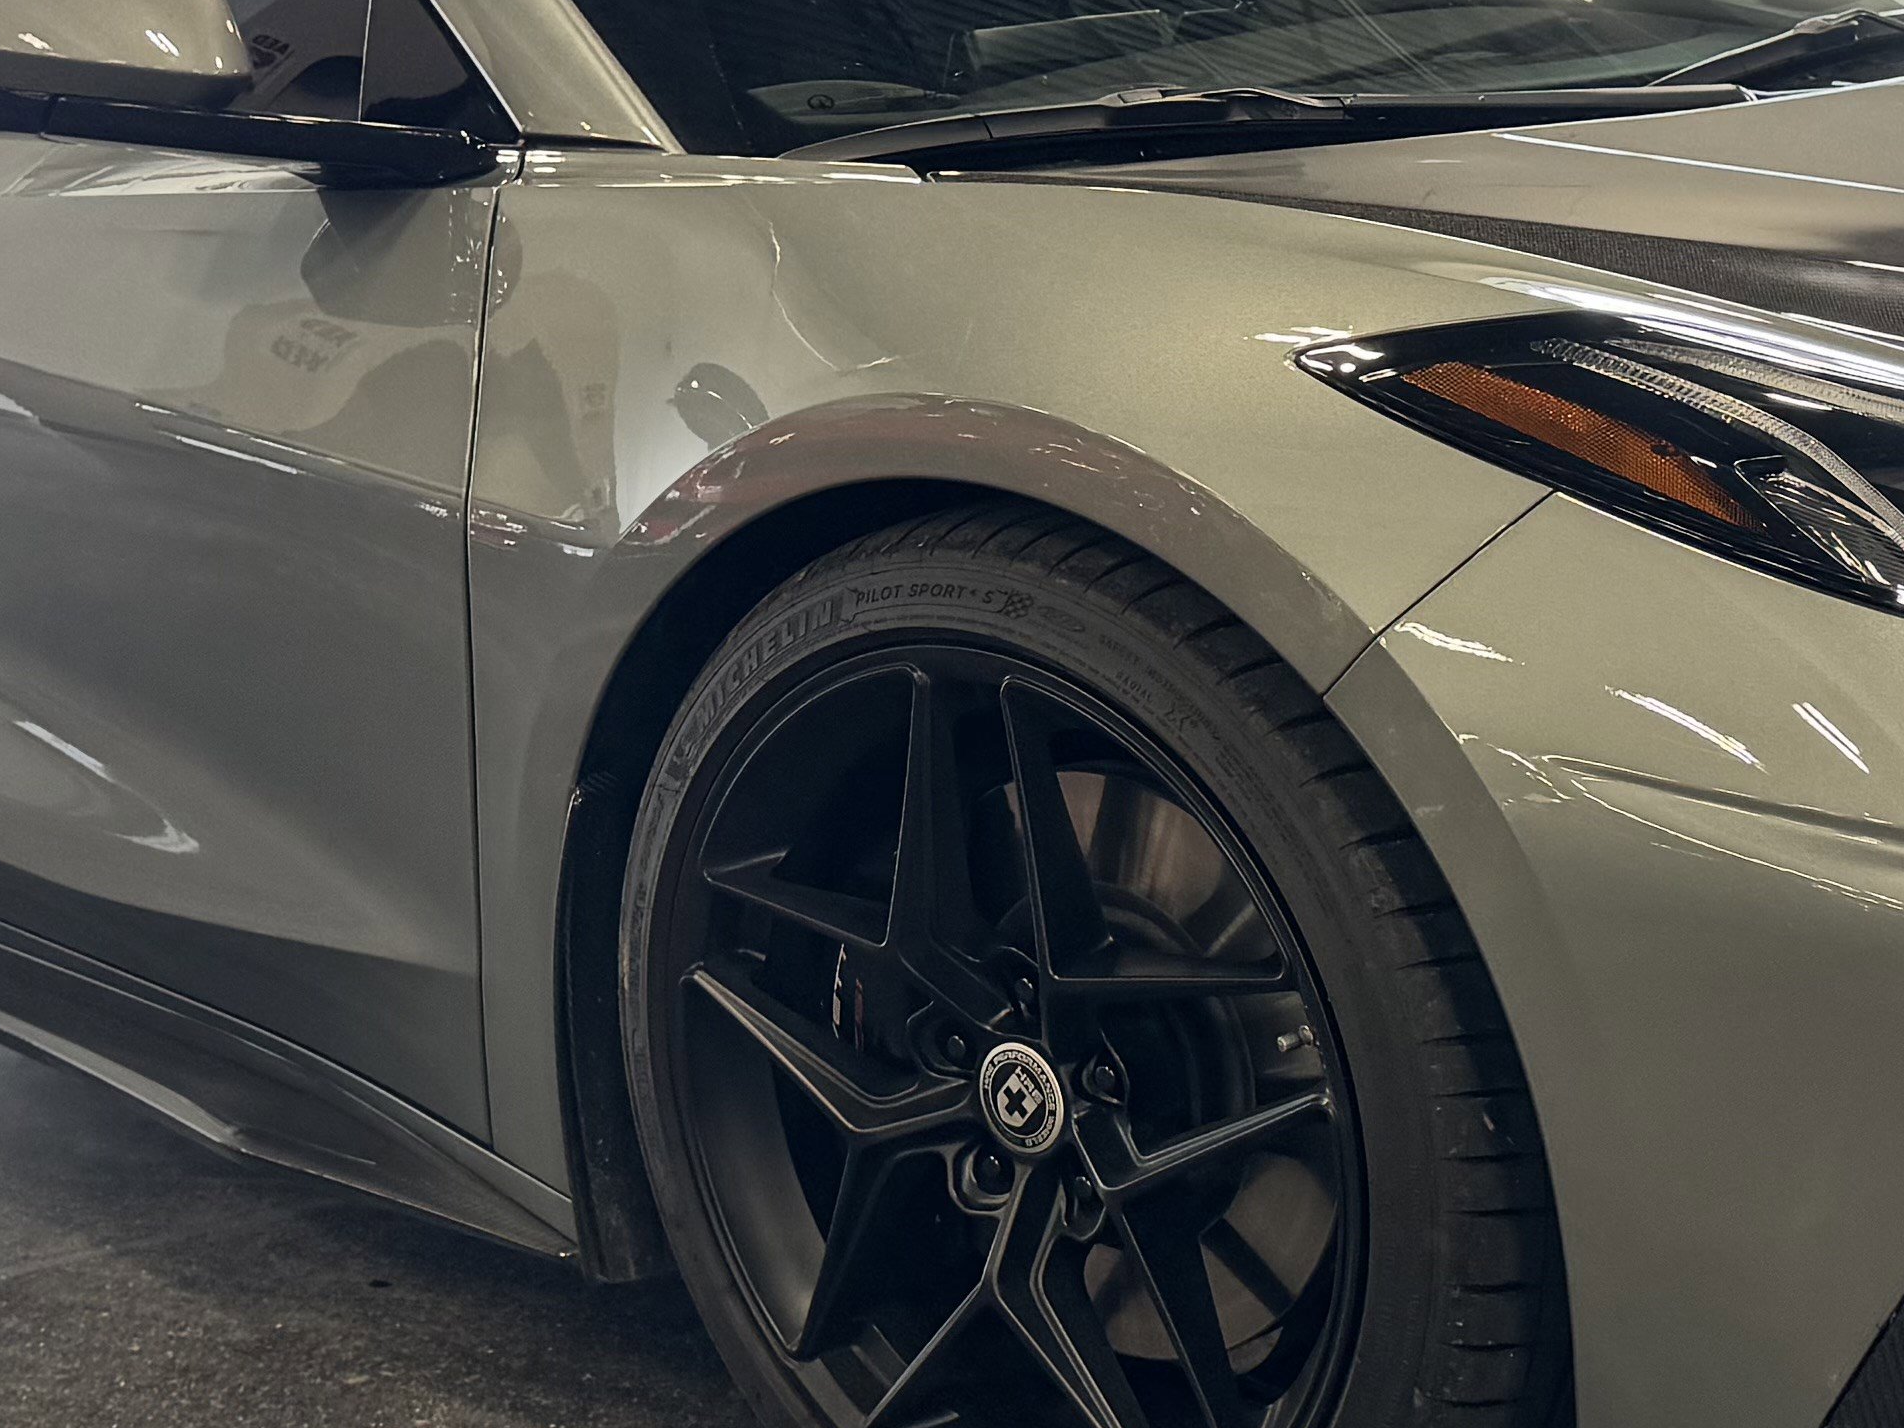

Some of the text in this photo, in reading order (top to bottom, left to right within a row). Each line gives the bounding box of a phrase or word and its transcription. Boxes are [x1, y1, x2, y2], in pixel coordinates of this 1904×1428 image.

[855, 584, 904, 608] PILOT
[908, 582, 967, 600] SPORT
[694, 599, 834, 734] MICHELIN
